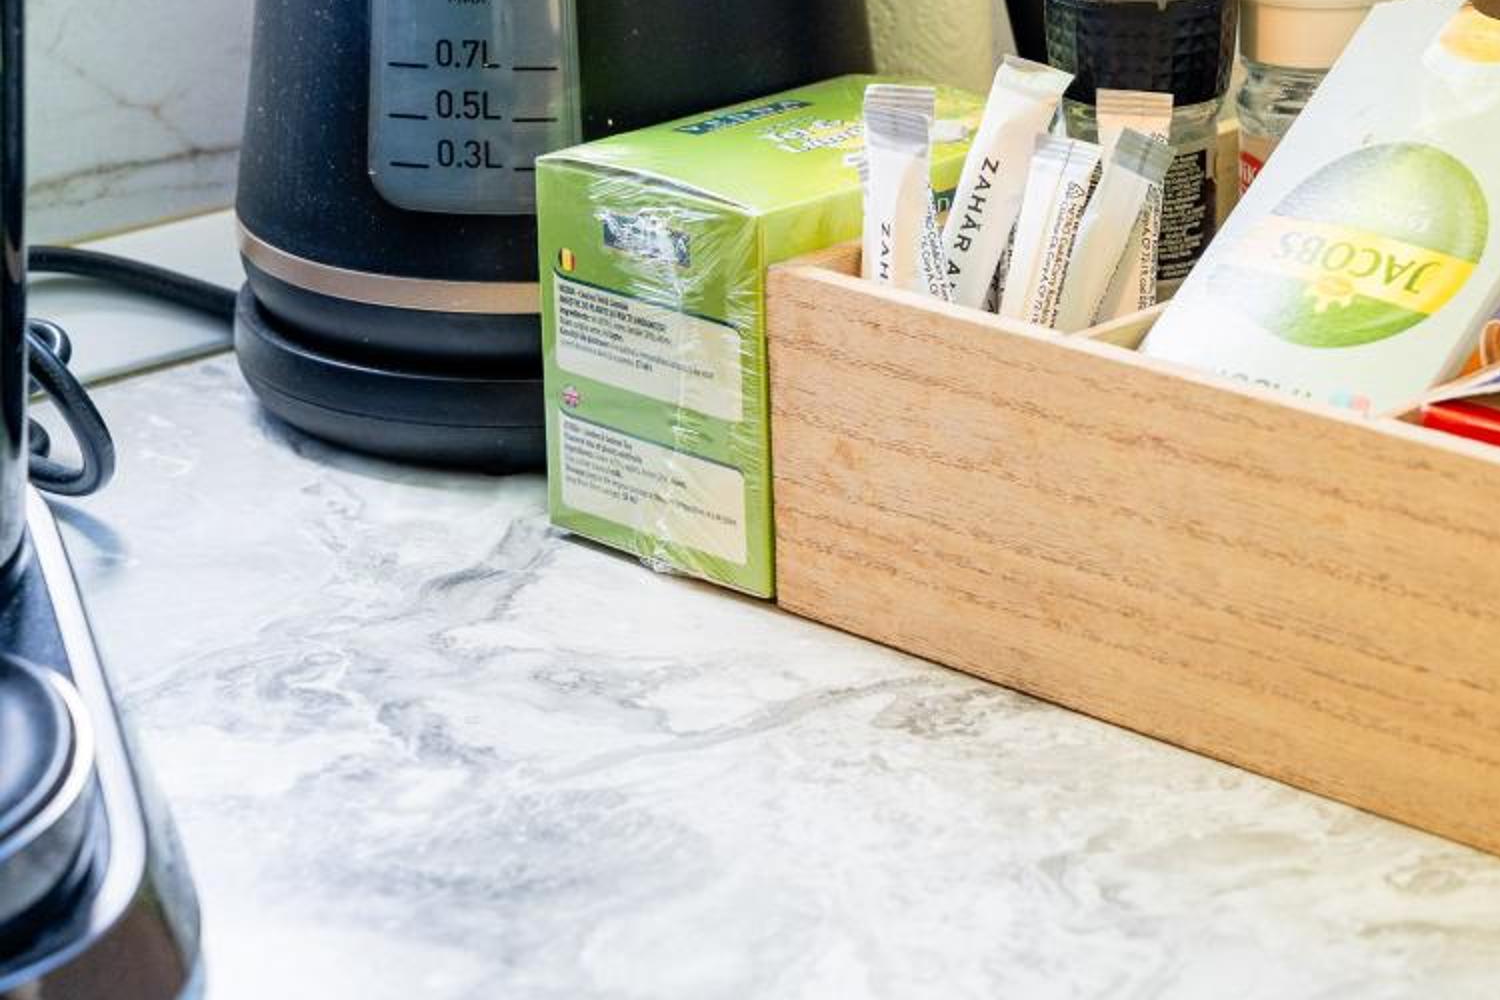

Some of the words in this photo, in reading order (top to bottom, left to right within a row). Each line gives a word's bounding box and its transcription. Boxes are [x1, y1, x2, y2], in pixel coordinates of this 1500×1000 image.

[435, 39, 500, 69] 0.7L
[436, 90, 502, 120] 0.5L
[437, 140, 503, 168] 0.3L
[879, 223, 891, 280] ZAH
[1272, 231, 1441, 294] JACOBS
